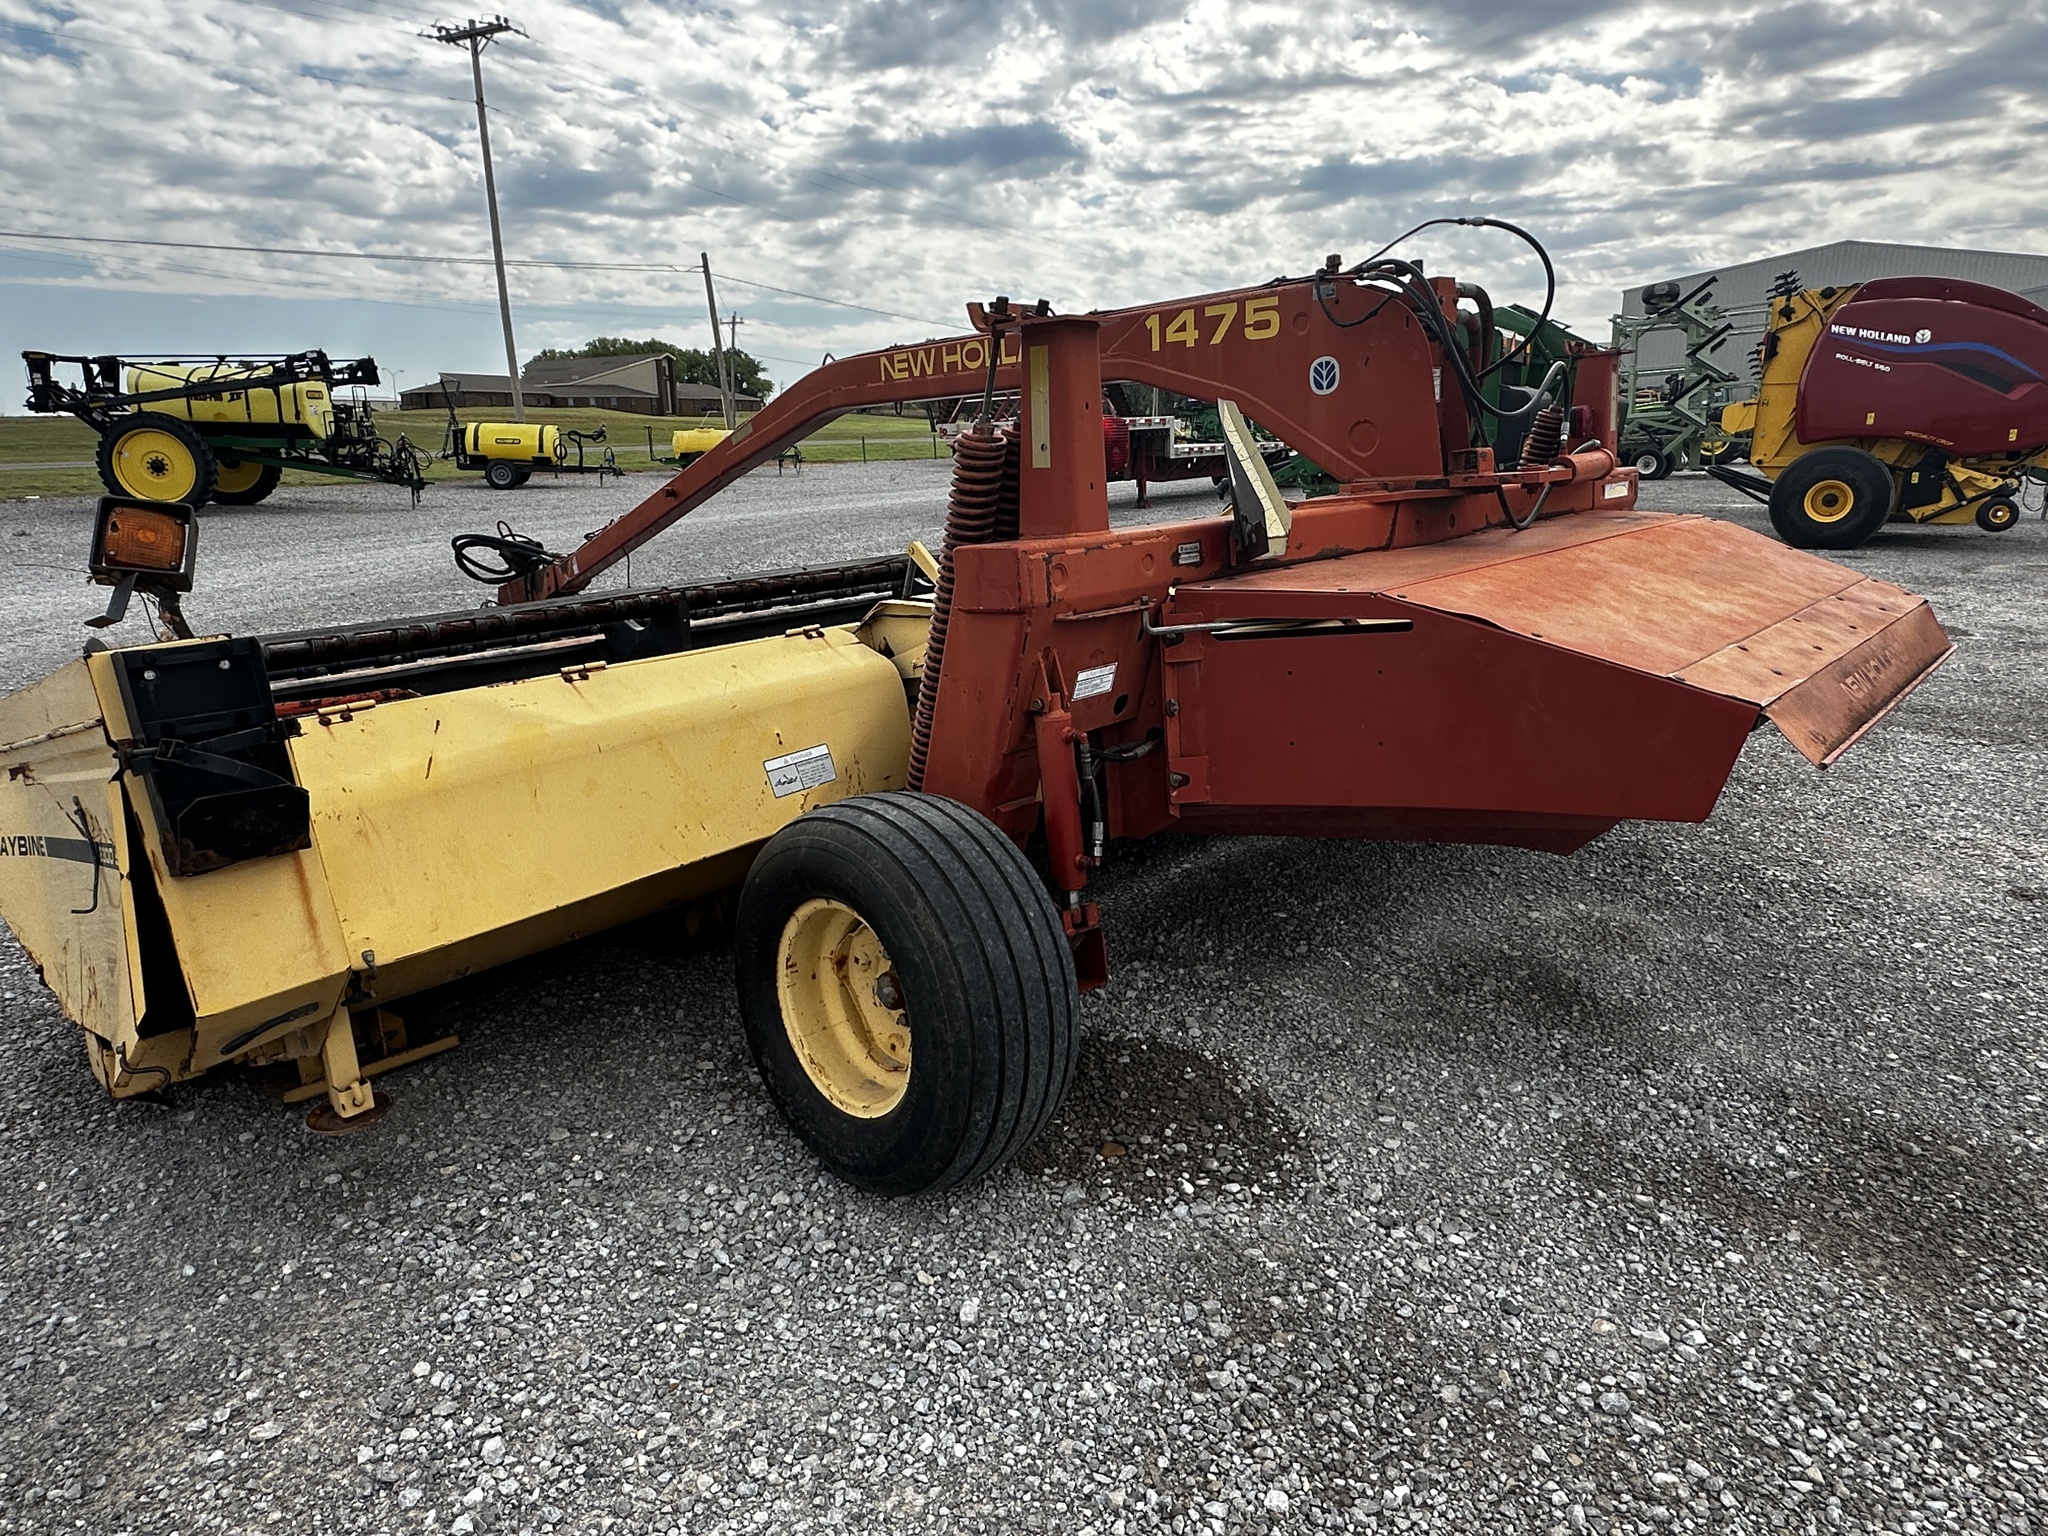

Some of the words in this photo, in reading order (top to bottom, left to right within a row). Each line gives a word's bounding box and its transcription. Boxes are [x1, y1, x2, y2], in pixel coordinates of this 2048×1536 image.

[1145, 296, 1280, 352] 1475
[1831, 324, 1857, 336] NEW
[1859, 328, 1911, 345] HOLLAND
[880, 347, 936, 381] NEW
[942, 338, 1022, 373] HOLL
[1835, 352, 1873, 367] ROLL-BELT
[1840, 669, 1872, 703] NEW
